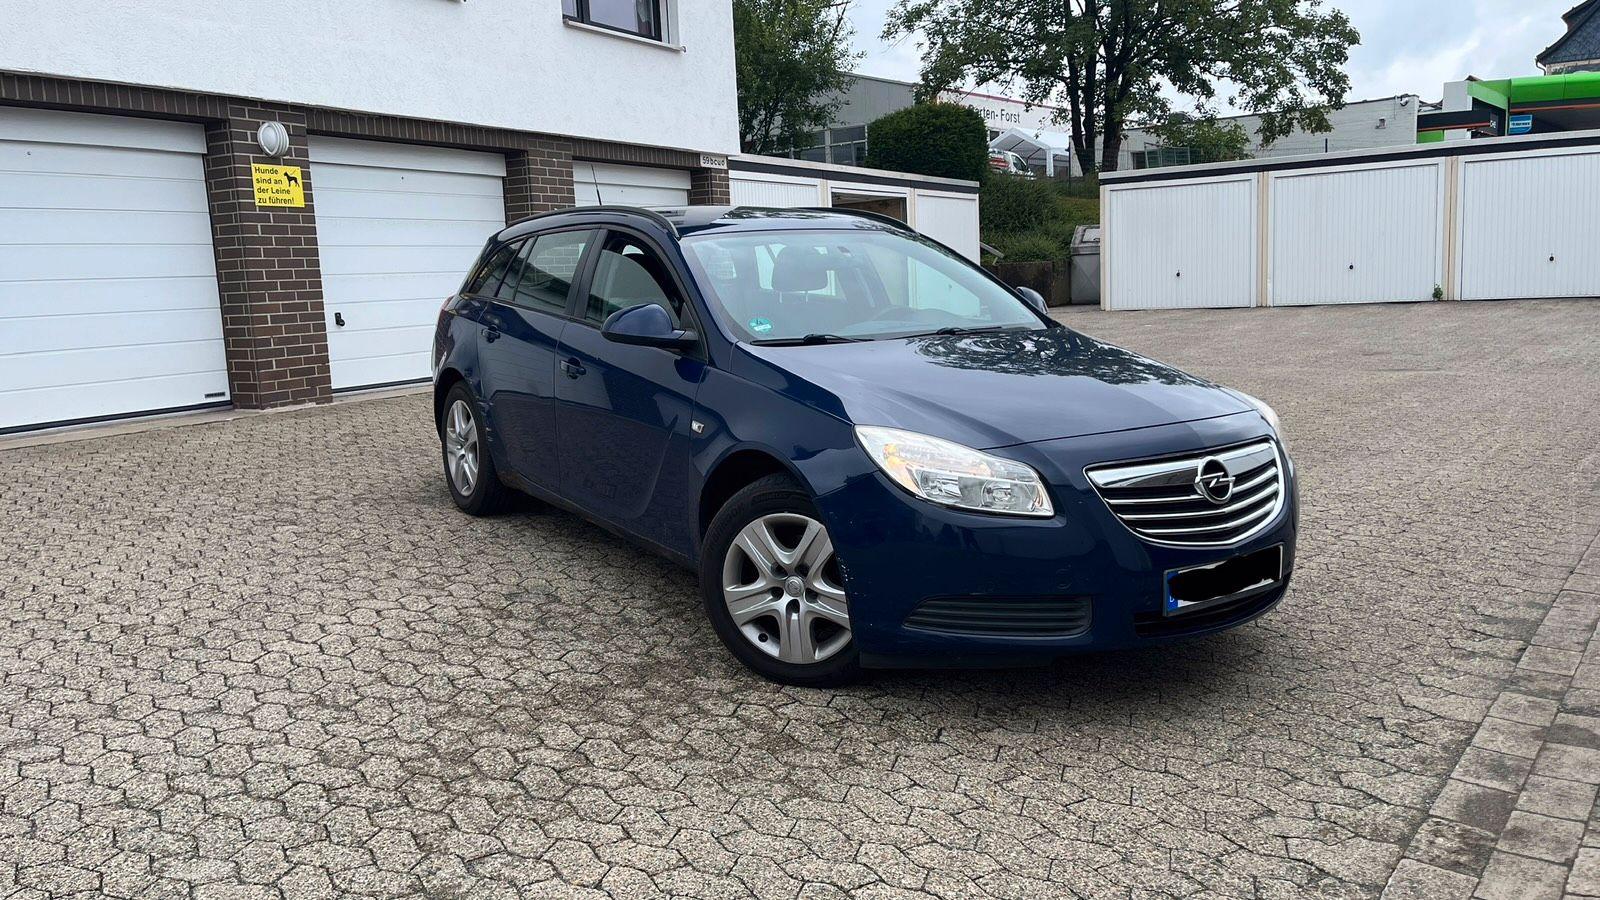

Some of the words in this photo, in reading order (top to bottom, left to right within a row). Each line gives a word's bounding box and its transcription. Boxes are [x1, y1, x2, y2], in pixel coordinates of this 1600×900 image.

[1000, 108, 1021, 123] Forst
[254, 166, 279, 174] Hunde
[256, 186, 269, 194] der
[270, 187, 291, 195] Leine
[268, 196, 295, 205] führen!
